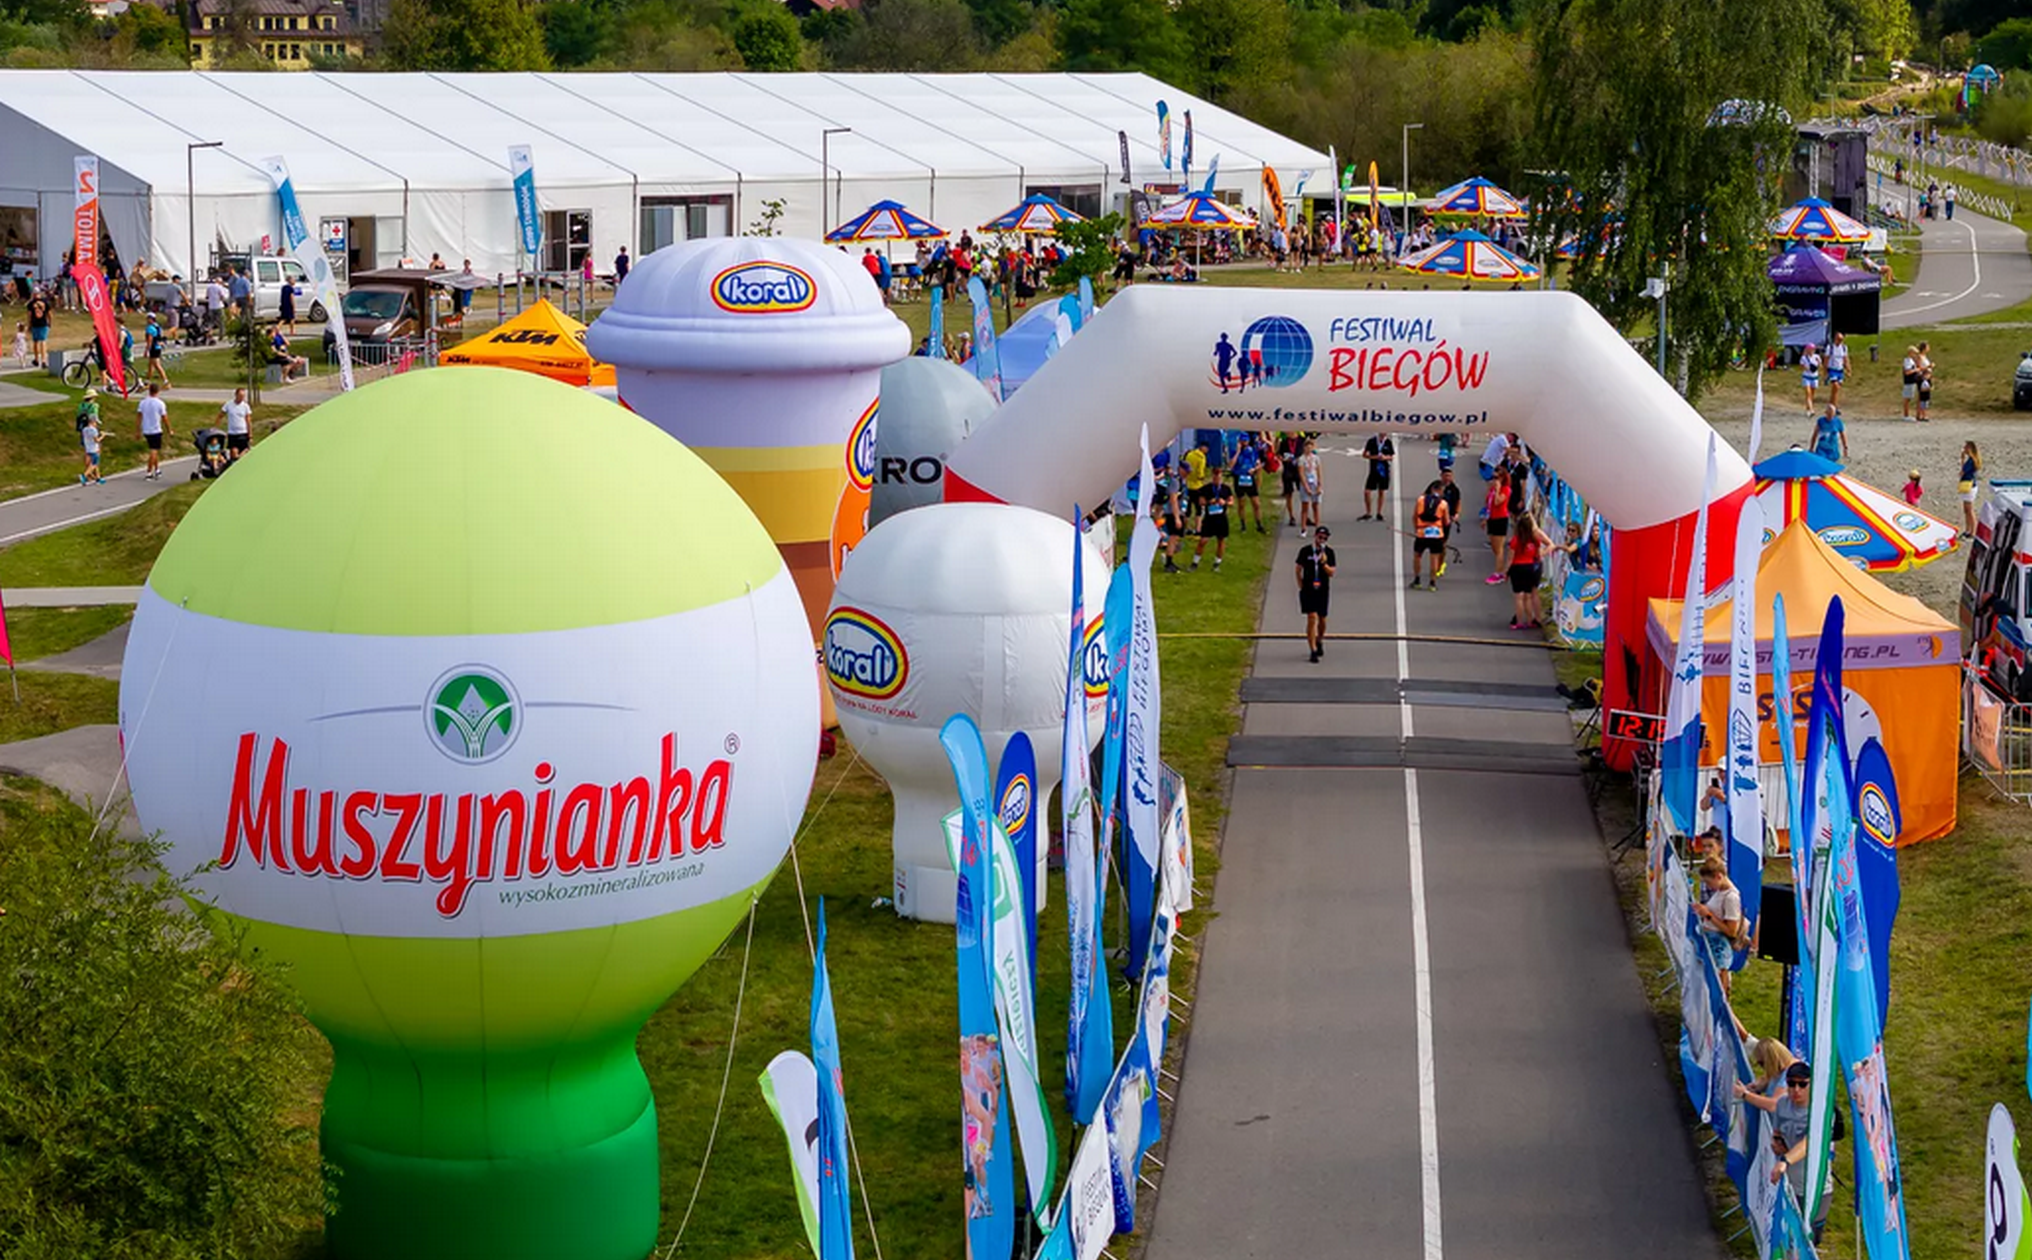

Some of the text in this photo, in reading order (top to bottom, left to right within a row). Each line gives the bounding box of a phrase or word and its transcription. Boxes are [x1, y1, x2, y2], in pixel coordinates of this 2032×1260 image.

[77, 208, 96, 265] TOIMA
[729, 275, 801, 305] koral
[489, 329, 560, 346] KTM
[1330, 317, 1437, 342] FESTIWAL
[1328, 339, 1490, 398] BIEGÓW
[1208, 407, 1489, 426] www.festiwalbiegow.pl
[826, 628, 887, 688] koral
[1757, 690, 1813, 721] SS
[220, 731, 735, 918] Muszynianka
[499, 861, 706, 906] wysokozmineralizowana
